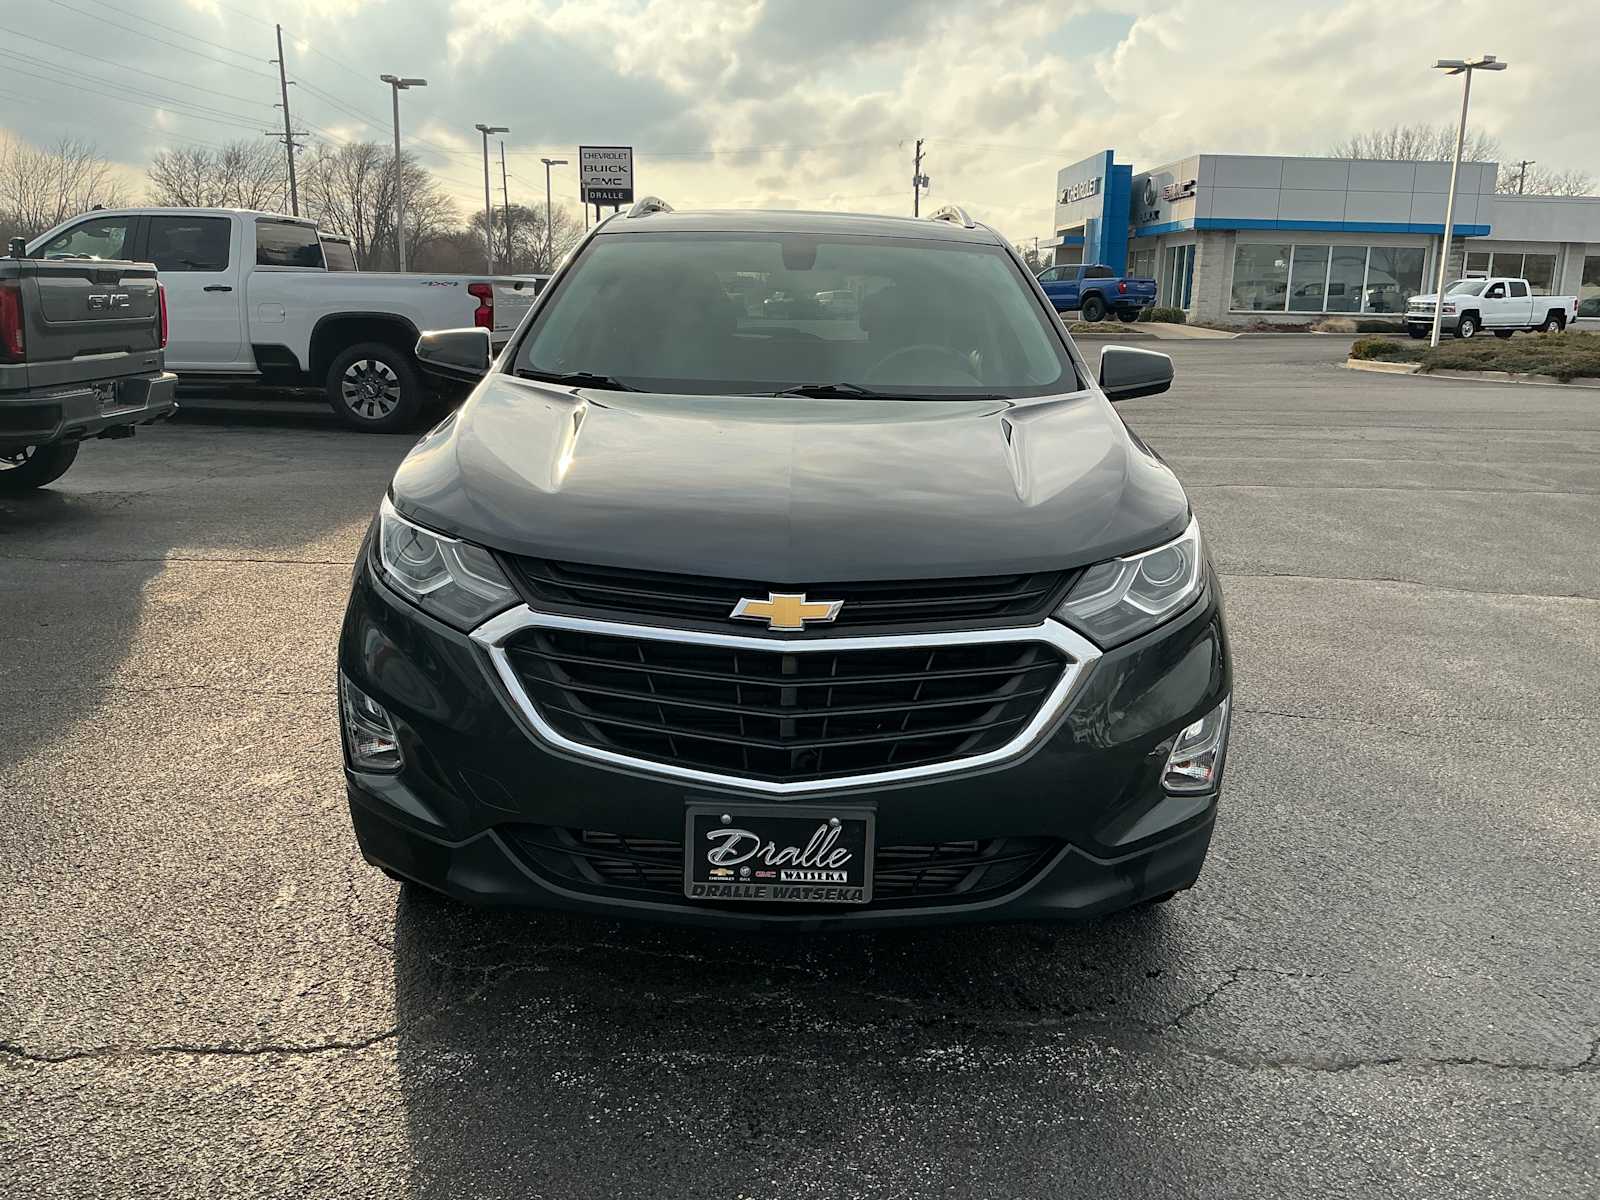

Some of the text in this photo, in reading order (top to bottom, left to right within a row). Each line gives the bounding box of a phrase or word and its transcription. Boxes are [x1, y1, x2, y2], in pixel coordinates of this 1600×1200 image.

[584, 152, 627, 160] CHEVROLET
[584, 164, 628, 173] BUICK
[590, 177, 623, 186] GMC
[590, 191, 624, 199] DRALLE
[1162, 179, 1197, 202] GMC
[88, 293, 130, 312] GMC
[706, 823, 852, 868] Dralle
[782, 870, 847, 881] WATSEKA
[691, 884, 863, 902] DRALLE WATSEKA
